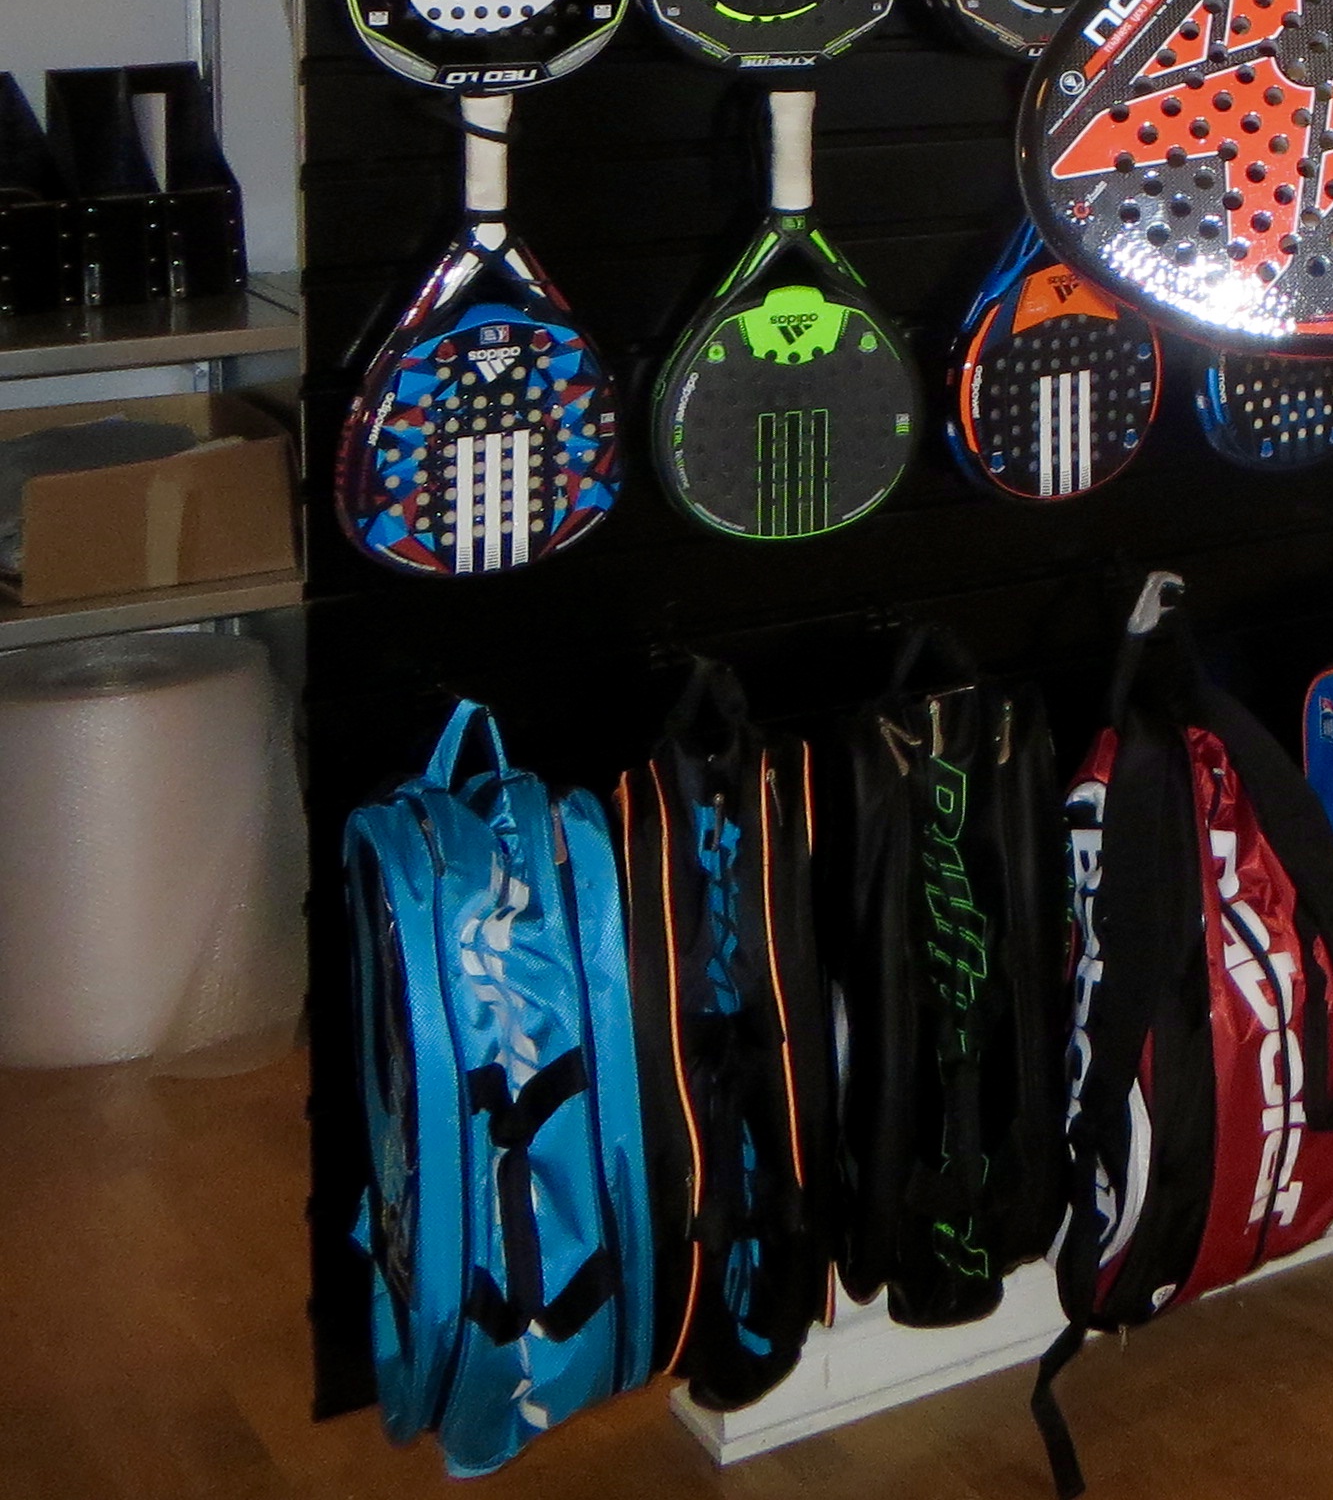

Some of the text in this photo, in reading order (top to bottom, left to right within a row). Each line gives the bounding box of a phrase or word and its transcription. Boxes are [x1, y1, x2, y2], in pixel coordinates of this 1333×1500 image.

[1103, 22, 1132, 53] makes
[1131, 3, 1149, 23] you
[769, 312, 819, 327] adidas
[466, 345, 522, 362] adidas
[675, 371, 701, 423] adipower
[971, 364, 984, 420] adipower
[367, 391, 397, 449] adipower
